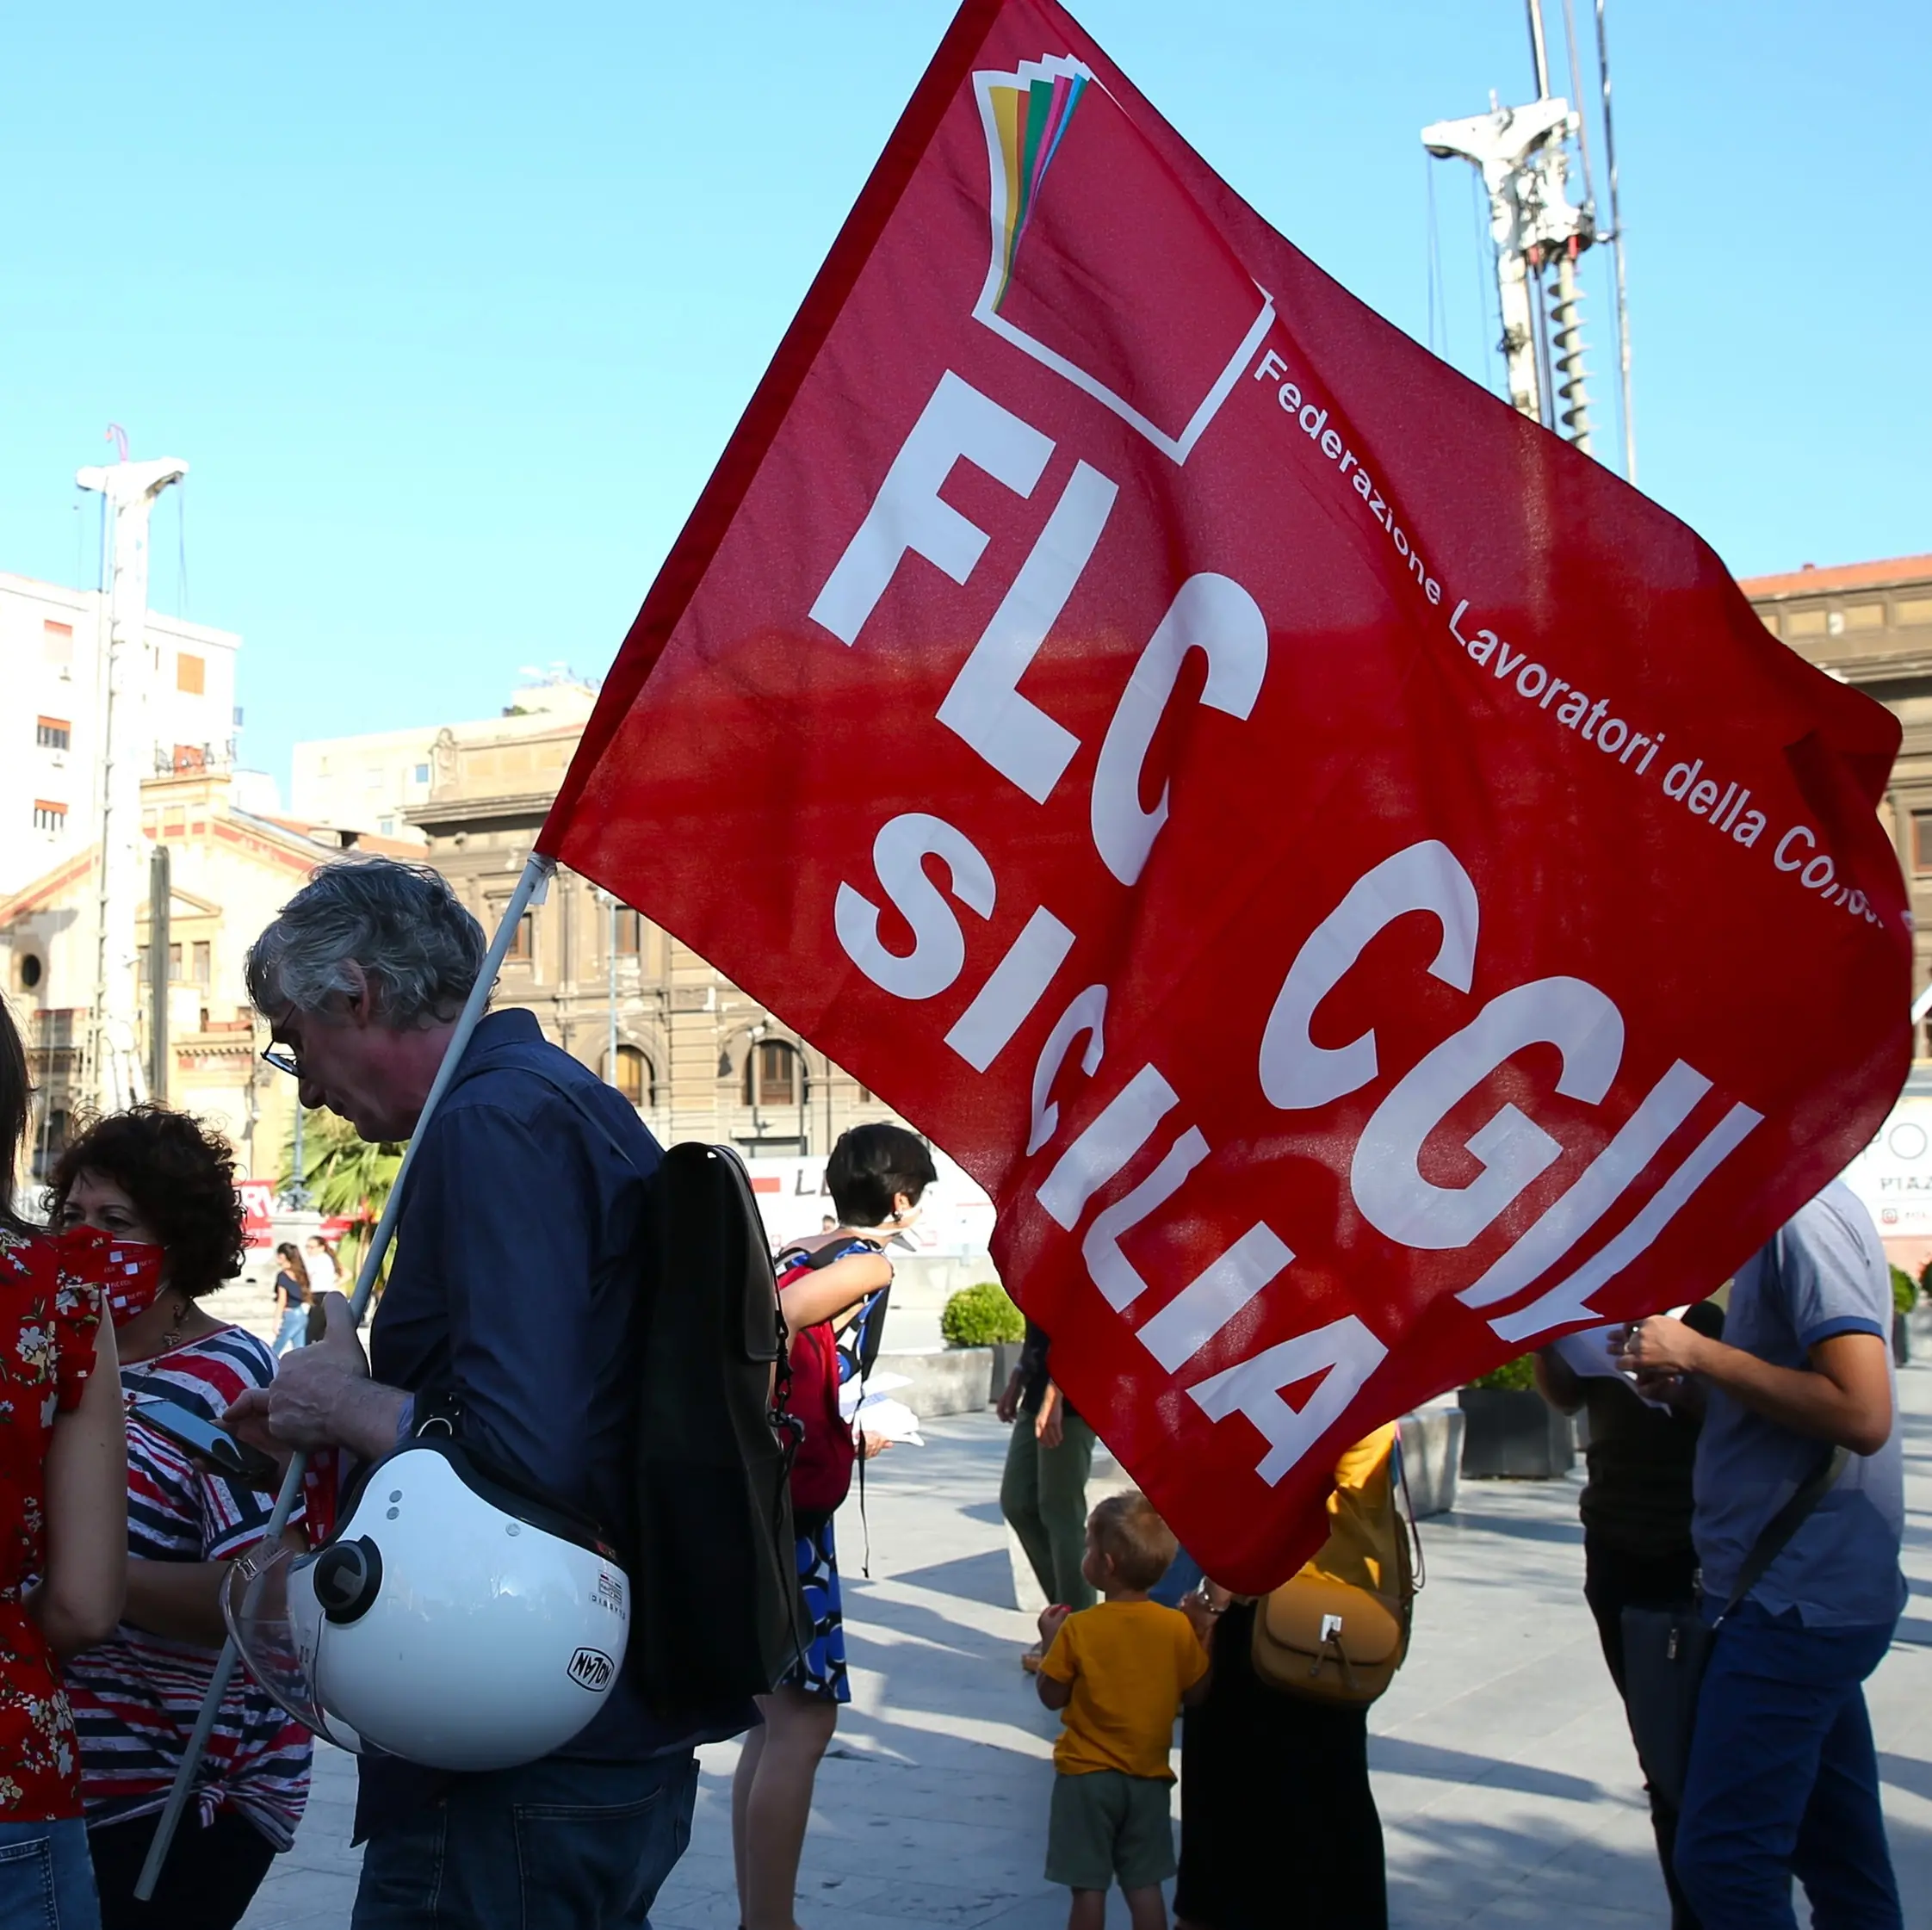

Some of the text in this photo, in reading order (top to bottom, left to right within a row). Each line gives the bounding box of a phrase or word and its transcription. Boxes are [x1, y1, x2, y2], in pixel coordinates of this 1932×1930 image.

[807, 368, 1765, 1344] FLC CGIL
[1254, 350, 1442, 607] Federazione
[1449, 598, 1666, 776] Lavoratori
[1663, 758, 1767, 849] della
[833, 812, 1390, 1488] SICILIA
[573, 1652, 612, 1685] NOLAN
